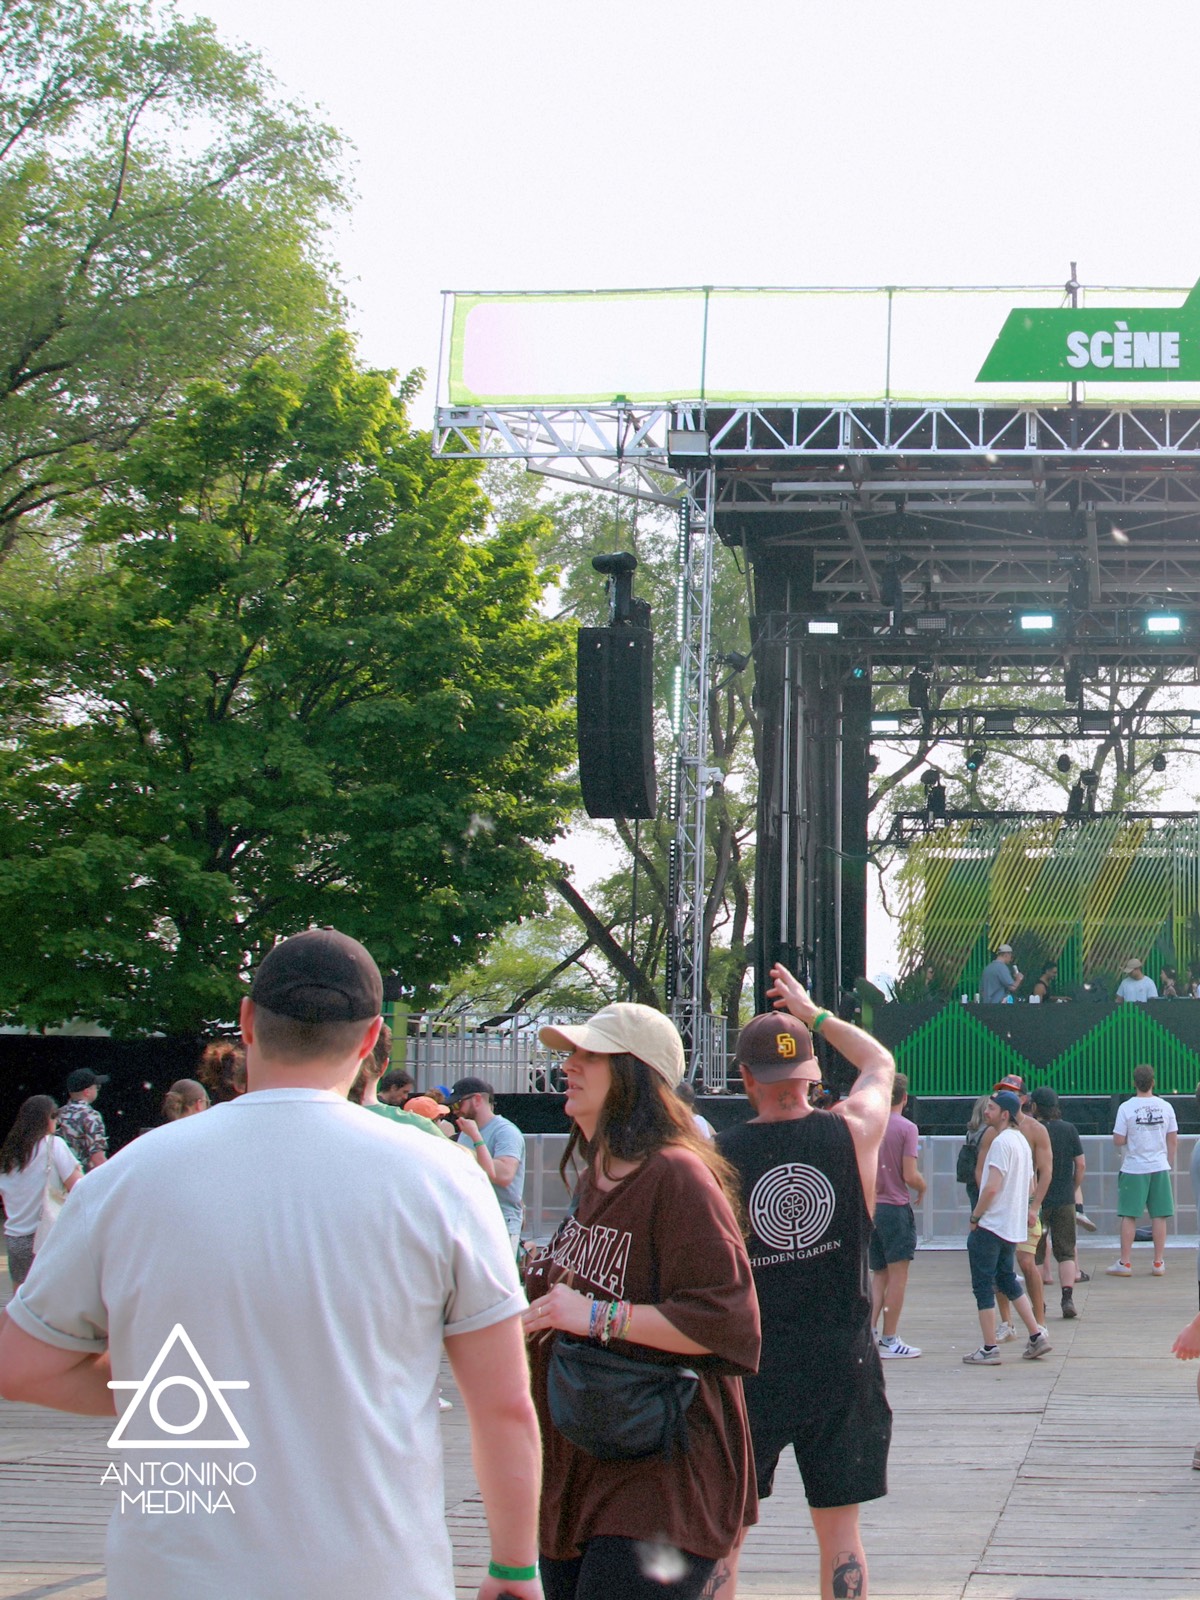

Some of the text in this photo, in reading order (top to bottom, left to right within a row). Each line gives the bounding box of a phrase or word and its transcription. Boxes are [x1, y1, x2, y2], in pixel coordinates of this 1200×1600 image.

[1066, 320, 1180, 368] SCÈNE
[749, 1240, 841, 1267] HIDDEN GARDEN
